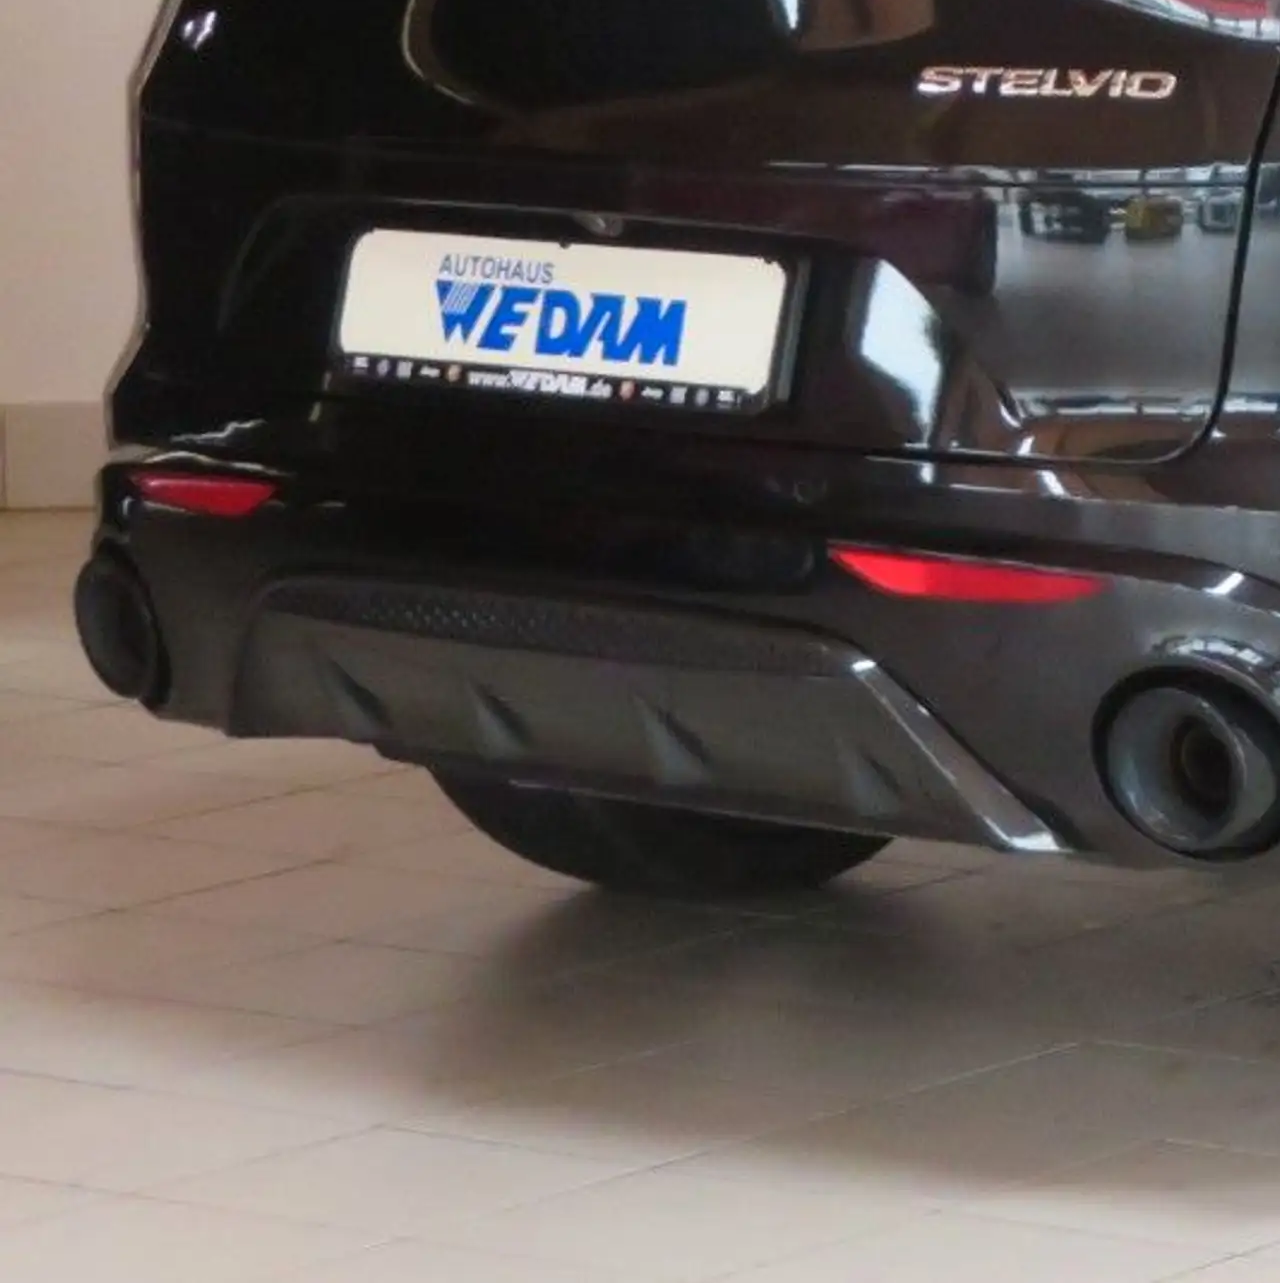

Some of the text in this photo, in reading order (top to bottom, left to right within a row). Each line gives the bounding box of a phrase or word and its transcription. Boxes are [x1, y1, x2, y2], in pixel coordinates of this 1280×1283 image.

[917, 66, 1178, 99] STELVIO
[439, 254, 554, 283] AUTOHAUS
[435, 279, 686, 366] WEDAM
